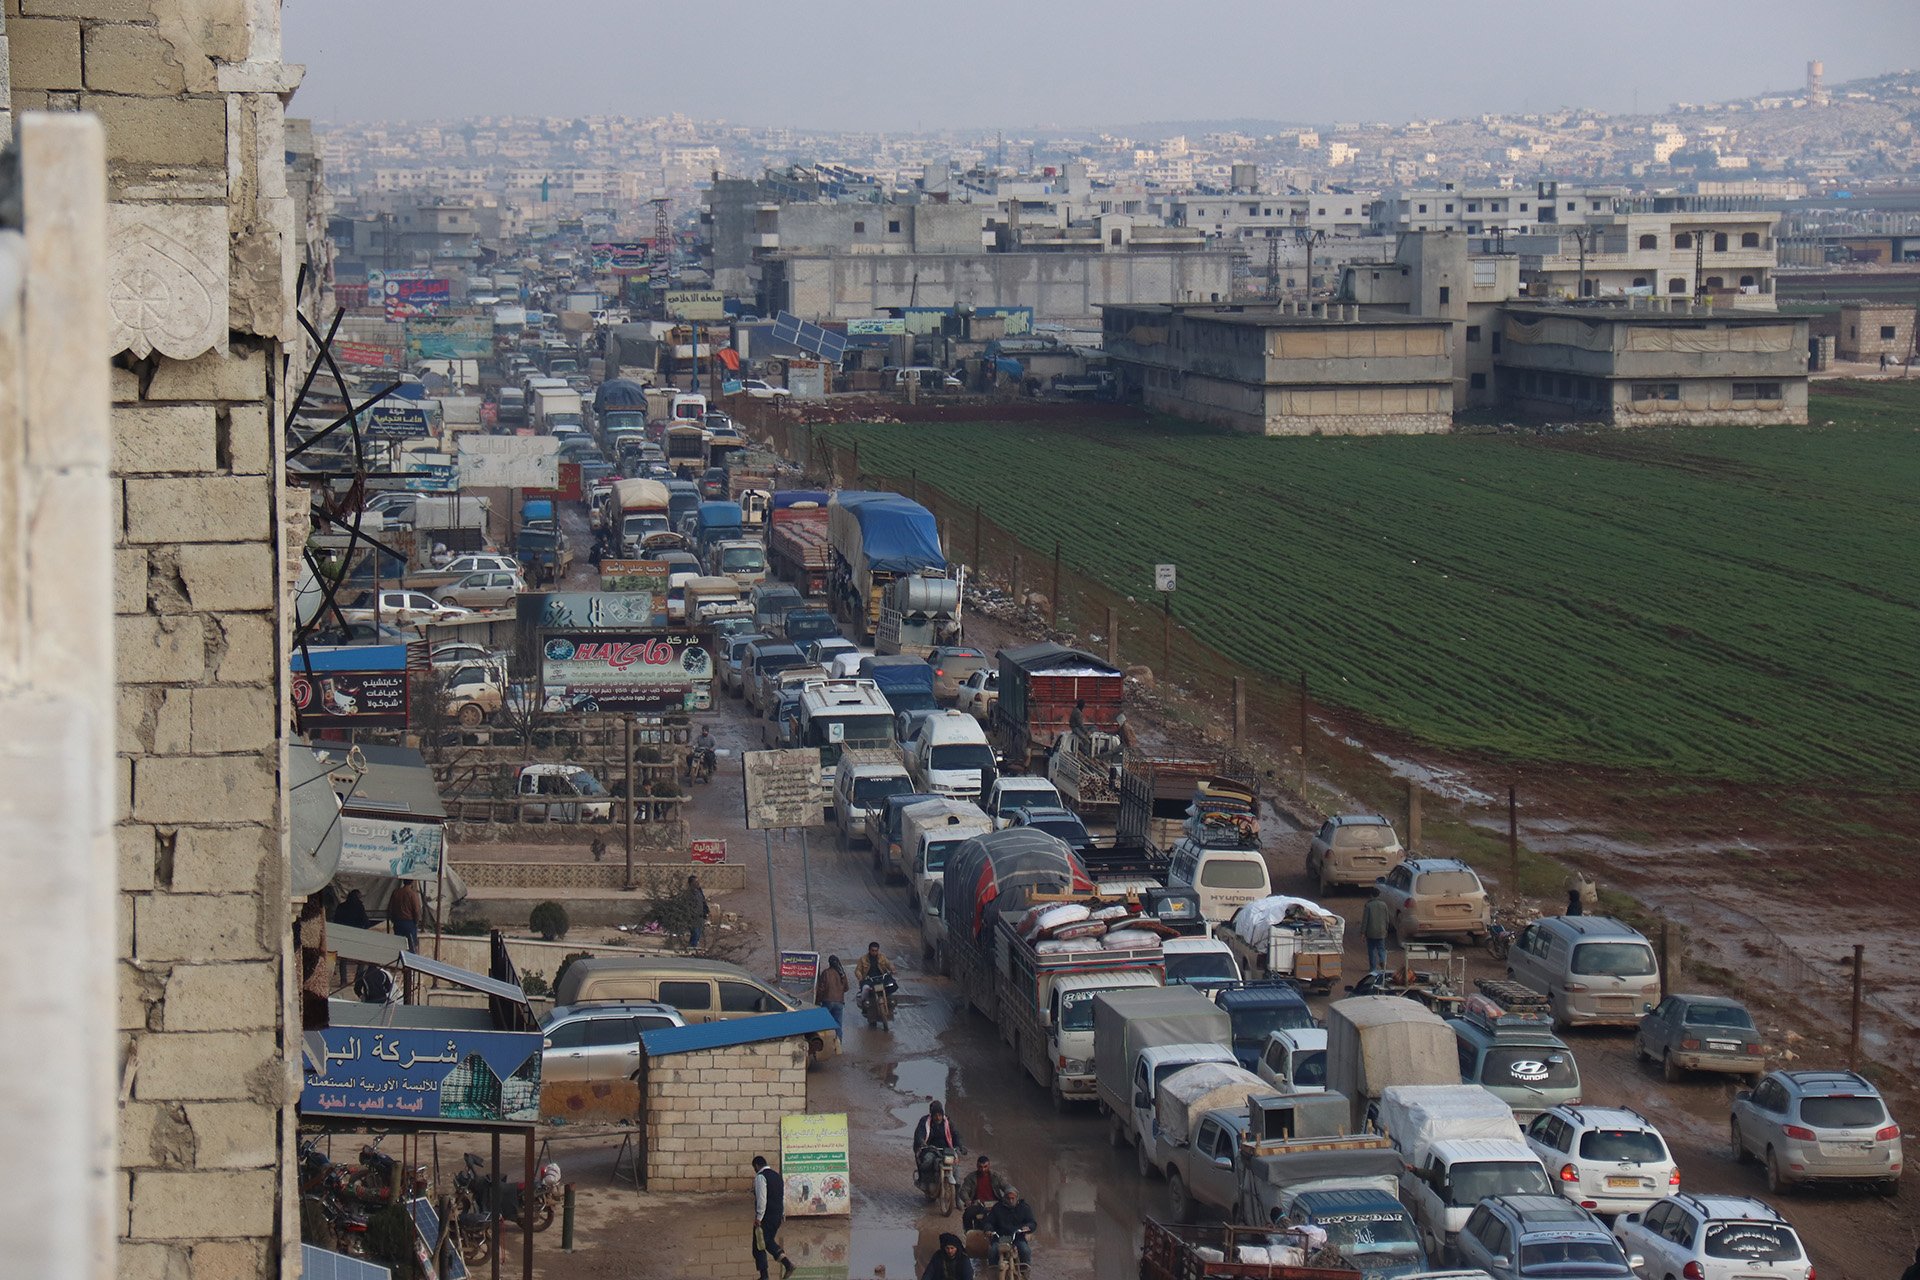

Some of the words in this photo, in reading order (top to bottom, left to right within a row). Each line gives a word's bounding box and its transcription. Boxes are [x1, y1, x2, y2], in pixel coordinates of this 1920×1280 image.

[667, 635, 699, 646] شركة
[363, 678, 398, 688] كابتشينو
[366, 689, 398, 698] ضيافات
[368, 699, 398, 708] شوكولا
[349, 824, 390, 839] شركة
[371, 1034, 458, 1069] شركة
[307, 1074, 355, 1088] المستعملة
[1511, 1071, 1549, 1081] HYUNDAI
[360, 1076, 398, 1092] الأوربية
[1317, 1213, 1403, 1225] HYUNDAI
